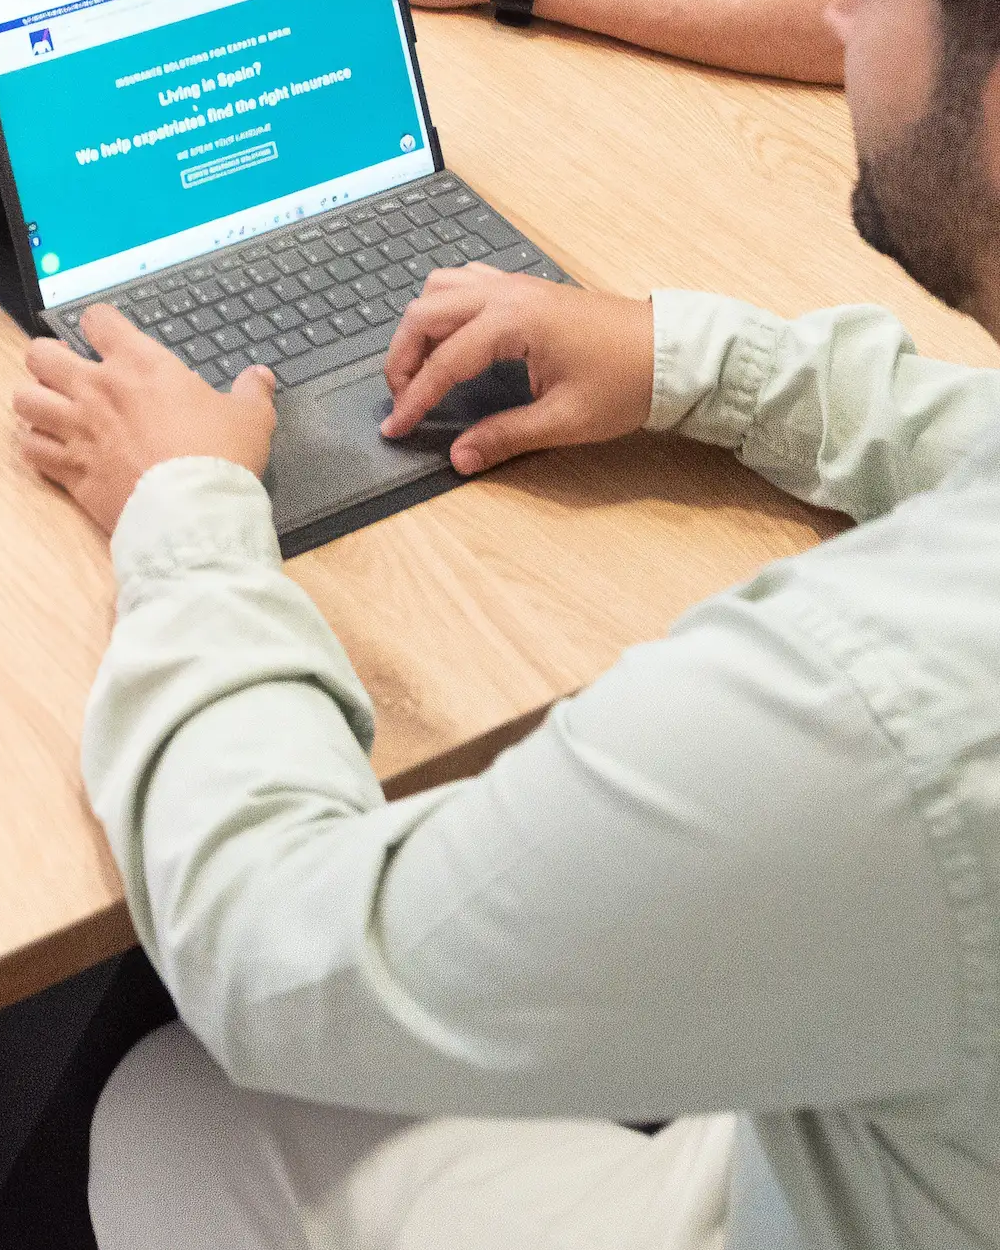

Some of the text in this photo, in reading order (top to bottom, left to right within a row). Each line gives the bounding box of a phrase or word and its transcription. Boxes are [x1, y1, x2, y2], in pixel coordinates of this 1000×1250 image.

[164, 52, 209, 73] SOLUTIONS
[210, 47, 226, 58] FOR
[268, 28, 291, 40] SPAIN
[159, 62, 261, 106] Living in Spain?
[76, 68, 352, 165] We help expatriates find the right insurance
